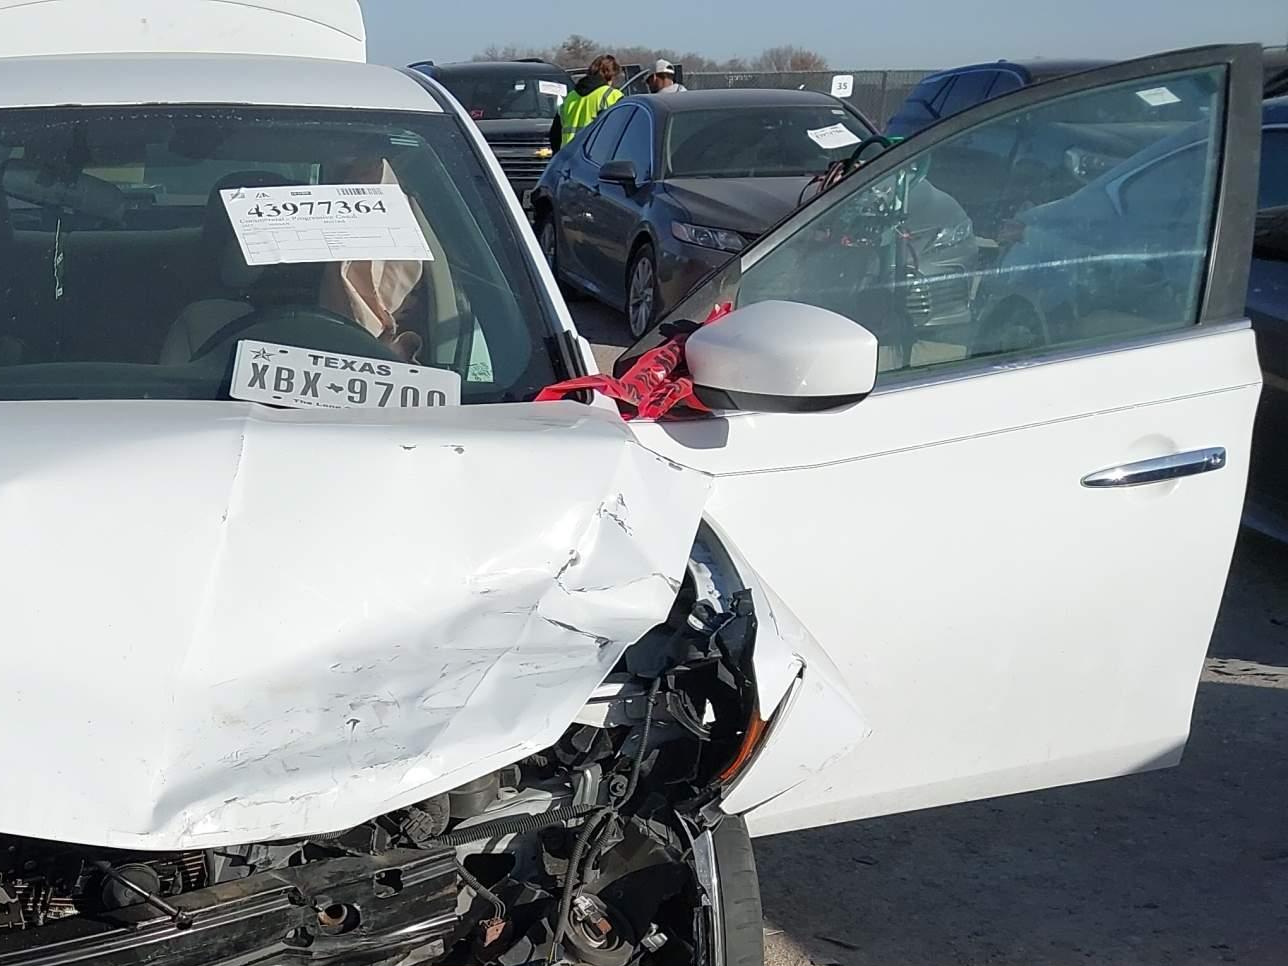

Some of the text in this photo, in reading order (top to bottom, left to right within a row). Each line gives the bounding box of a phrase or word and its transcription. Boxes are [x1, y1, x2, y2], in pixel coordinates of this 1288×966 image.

[836, 82, 848, 90] 35
[247, 200, 387, 218] 43977364
[308, 354, 392, 376] TEXAS
